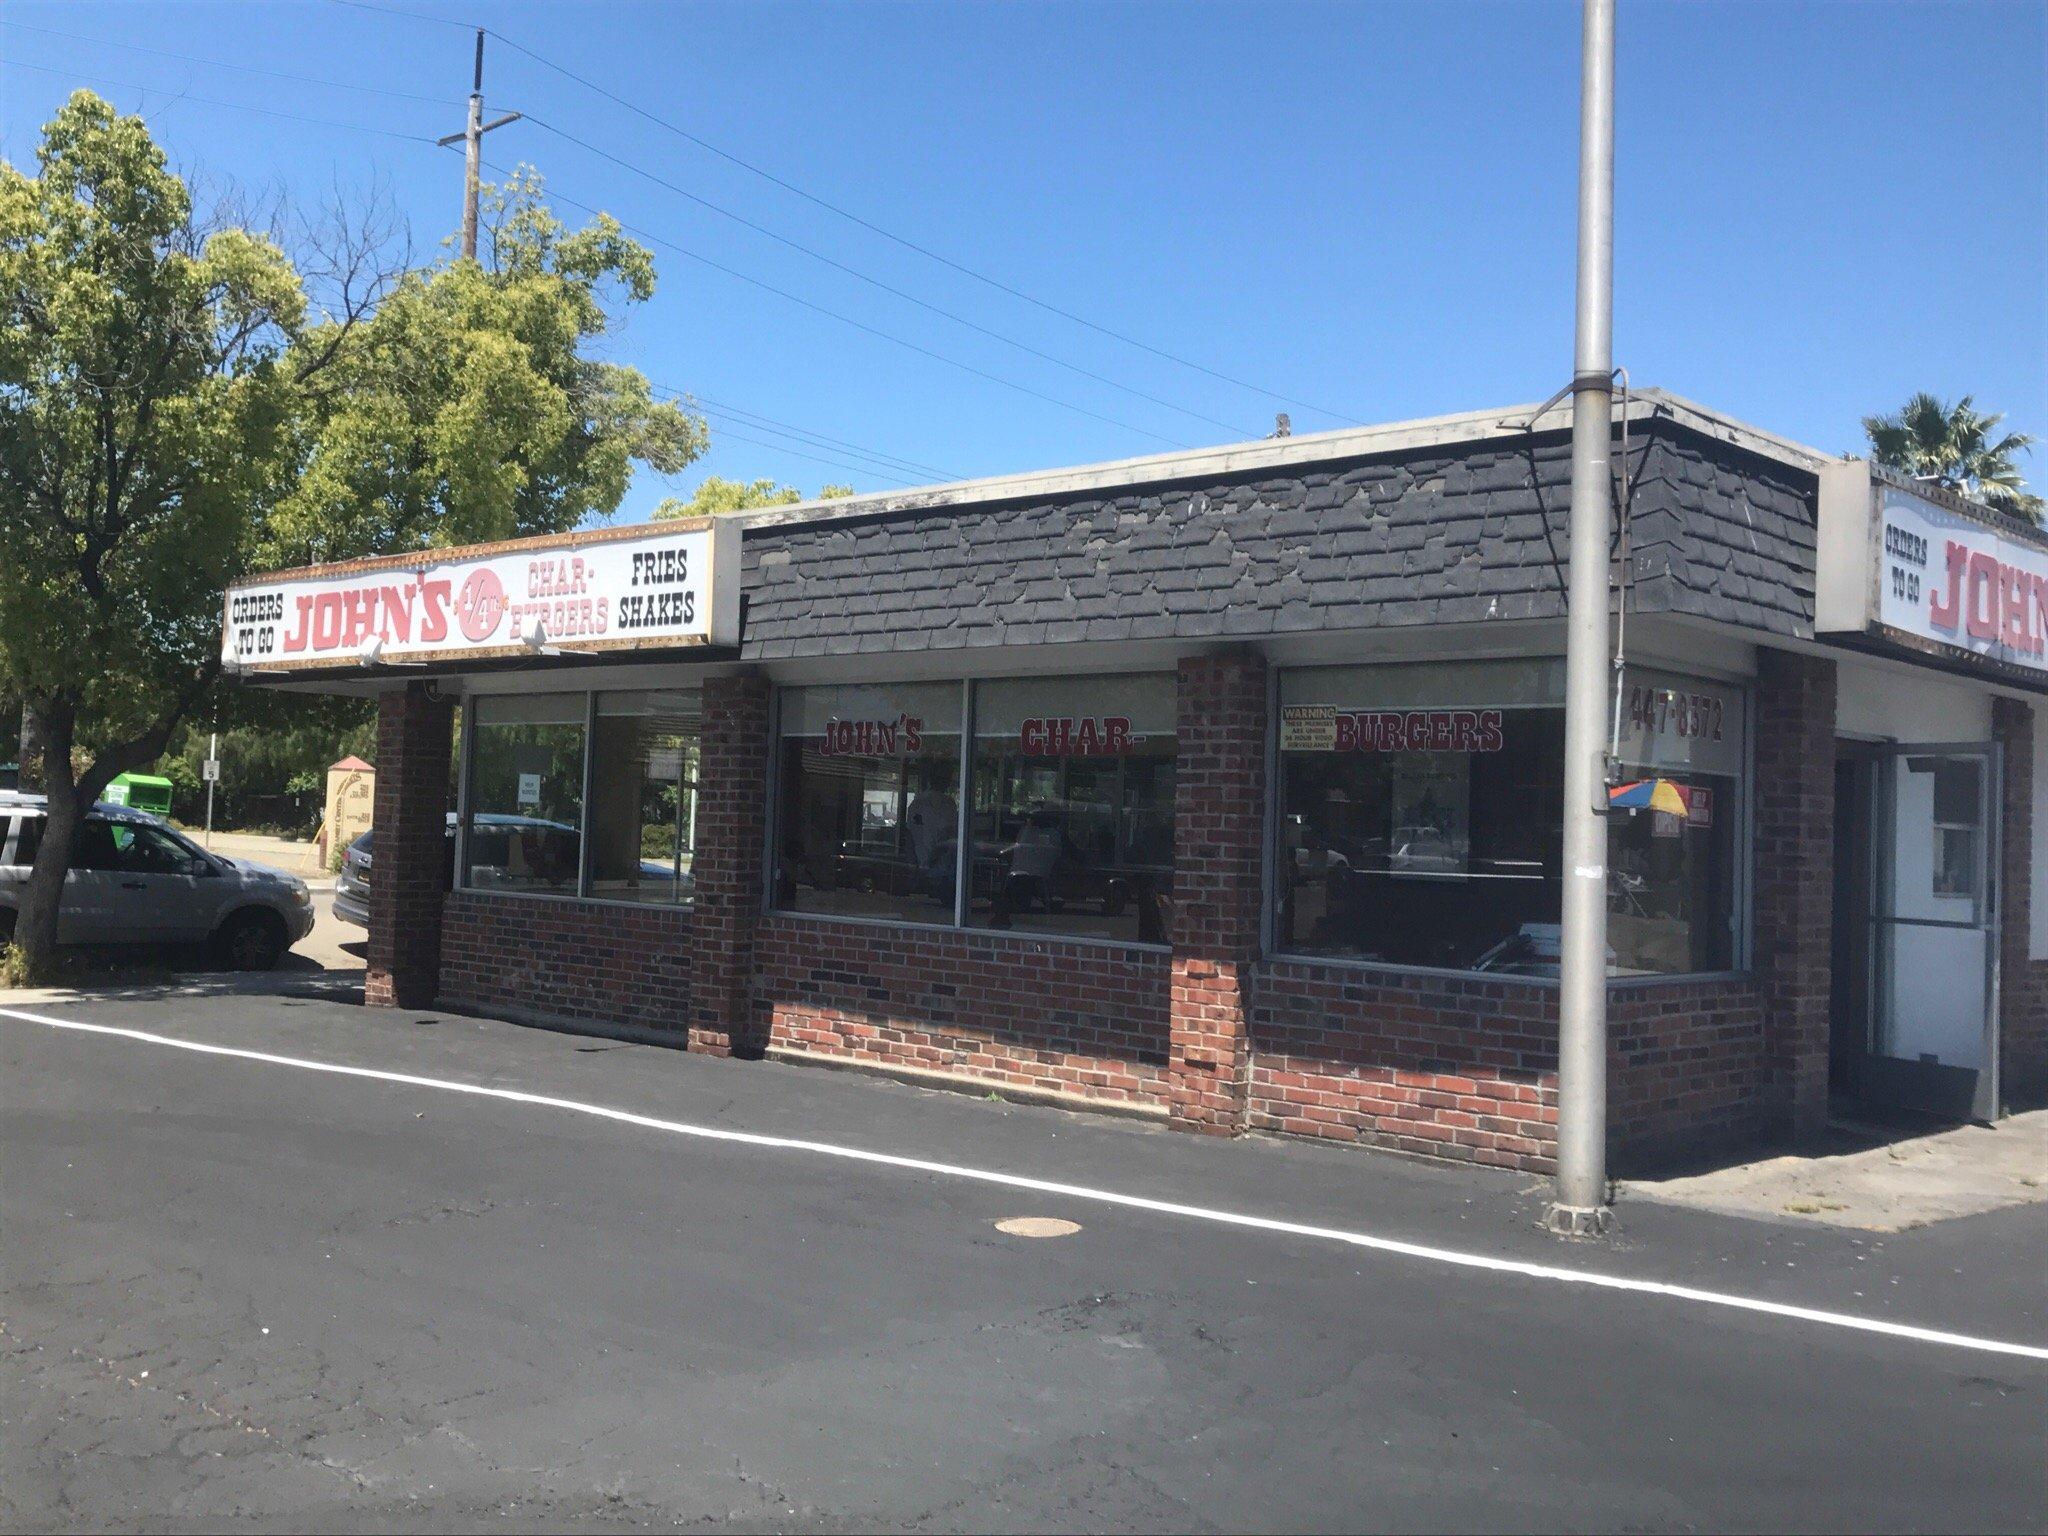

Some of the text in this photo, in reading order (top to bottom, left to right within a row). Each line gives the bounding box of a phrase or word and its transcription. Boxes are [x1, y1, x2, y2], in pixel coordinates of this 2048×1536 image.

[1885, 523, 1928, 567] ORDERS
[528, 557, 595, 599] CHAR-
[631, 549, 688, 587] FRIES
[1892, 566, 1920, 603] TO GO
[233, 593, 283, 624] ORDERS
[284, 570, 451, 654] JOHN'S
[618, 591, 695, 629] SHAKES
[239, 626, 274, 654] TO GO
[1283, 707, 1335, 719] WARNING
[1335, 711, 1503, 753] BURGERS
[819, 713, 924, 757] JOHN'S
[1021, 716, 1147, 757] CHAR-
